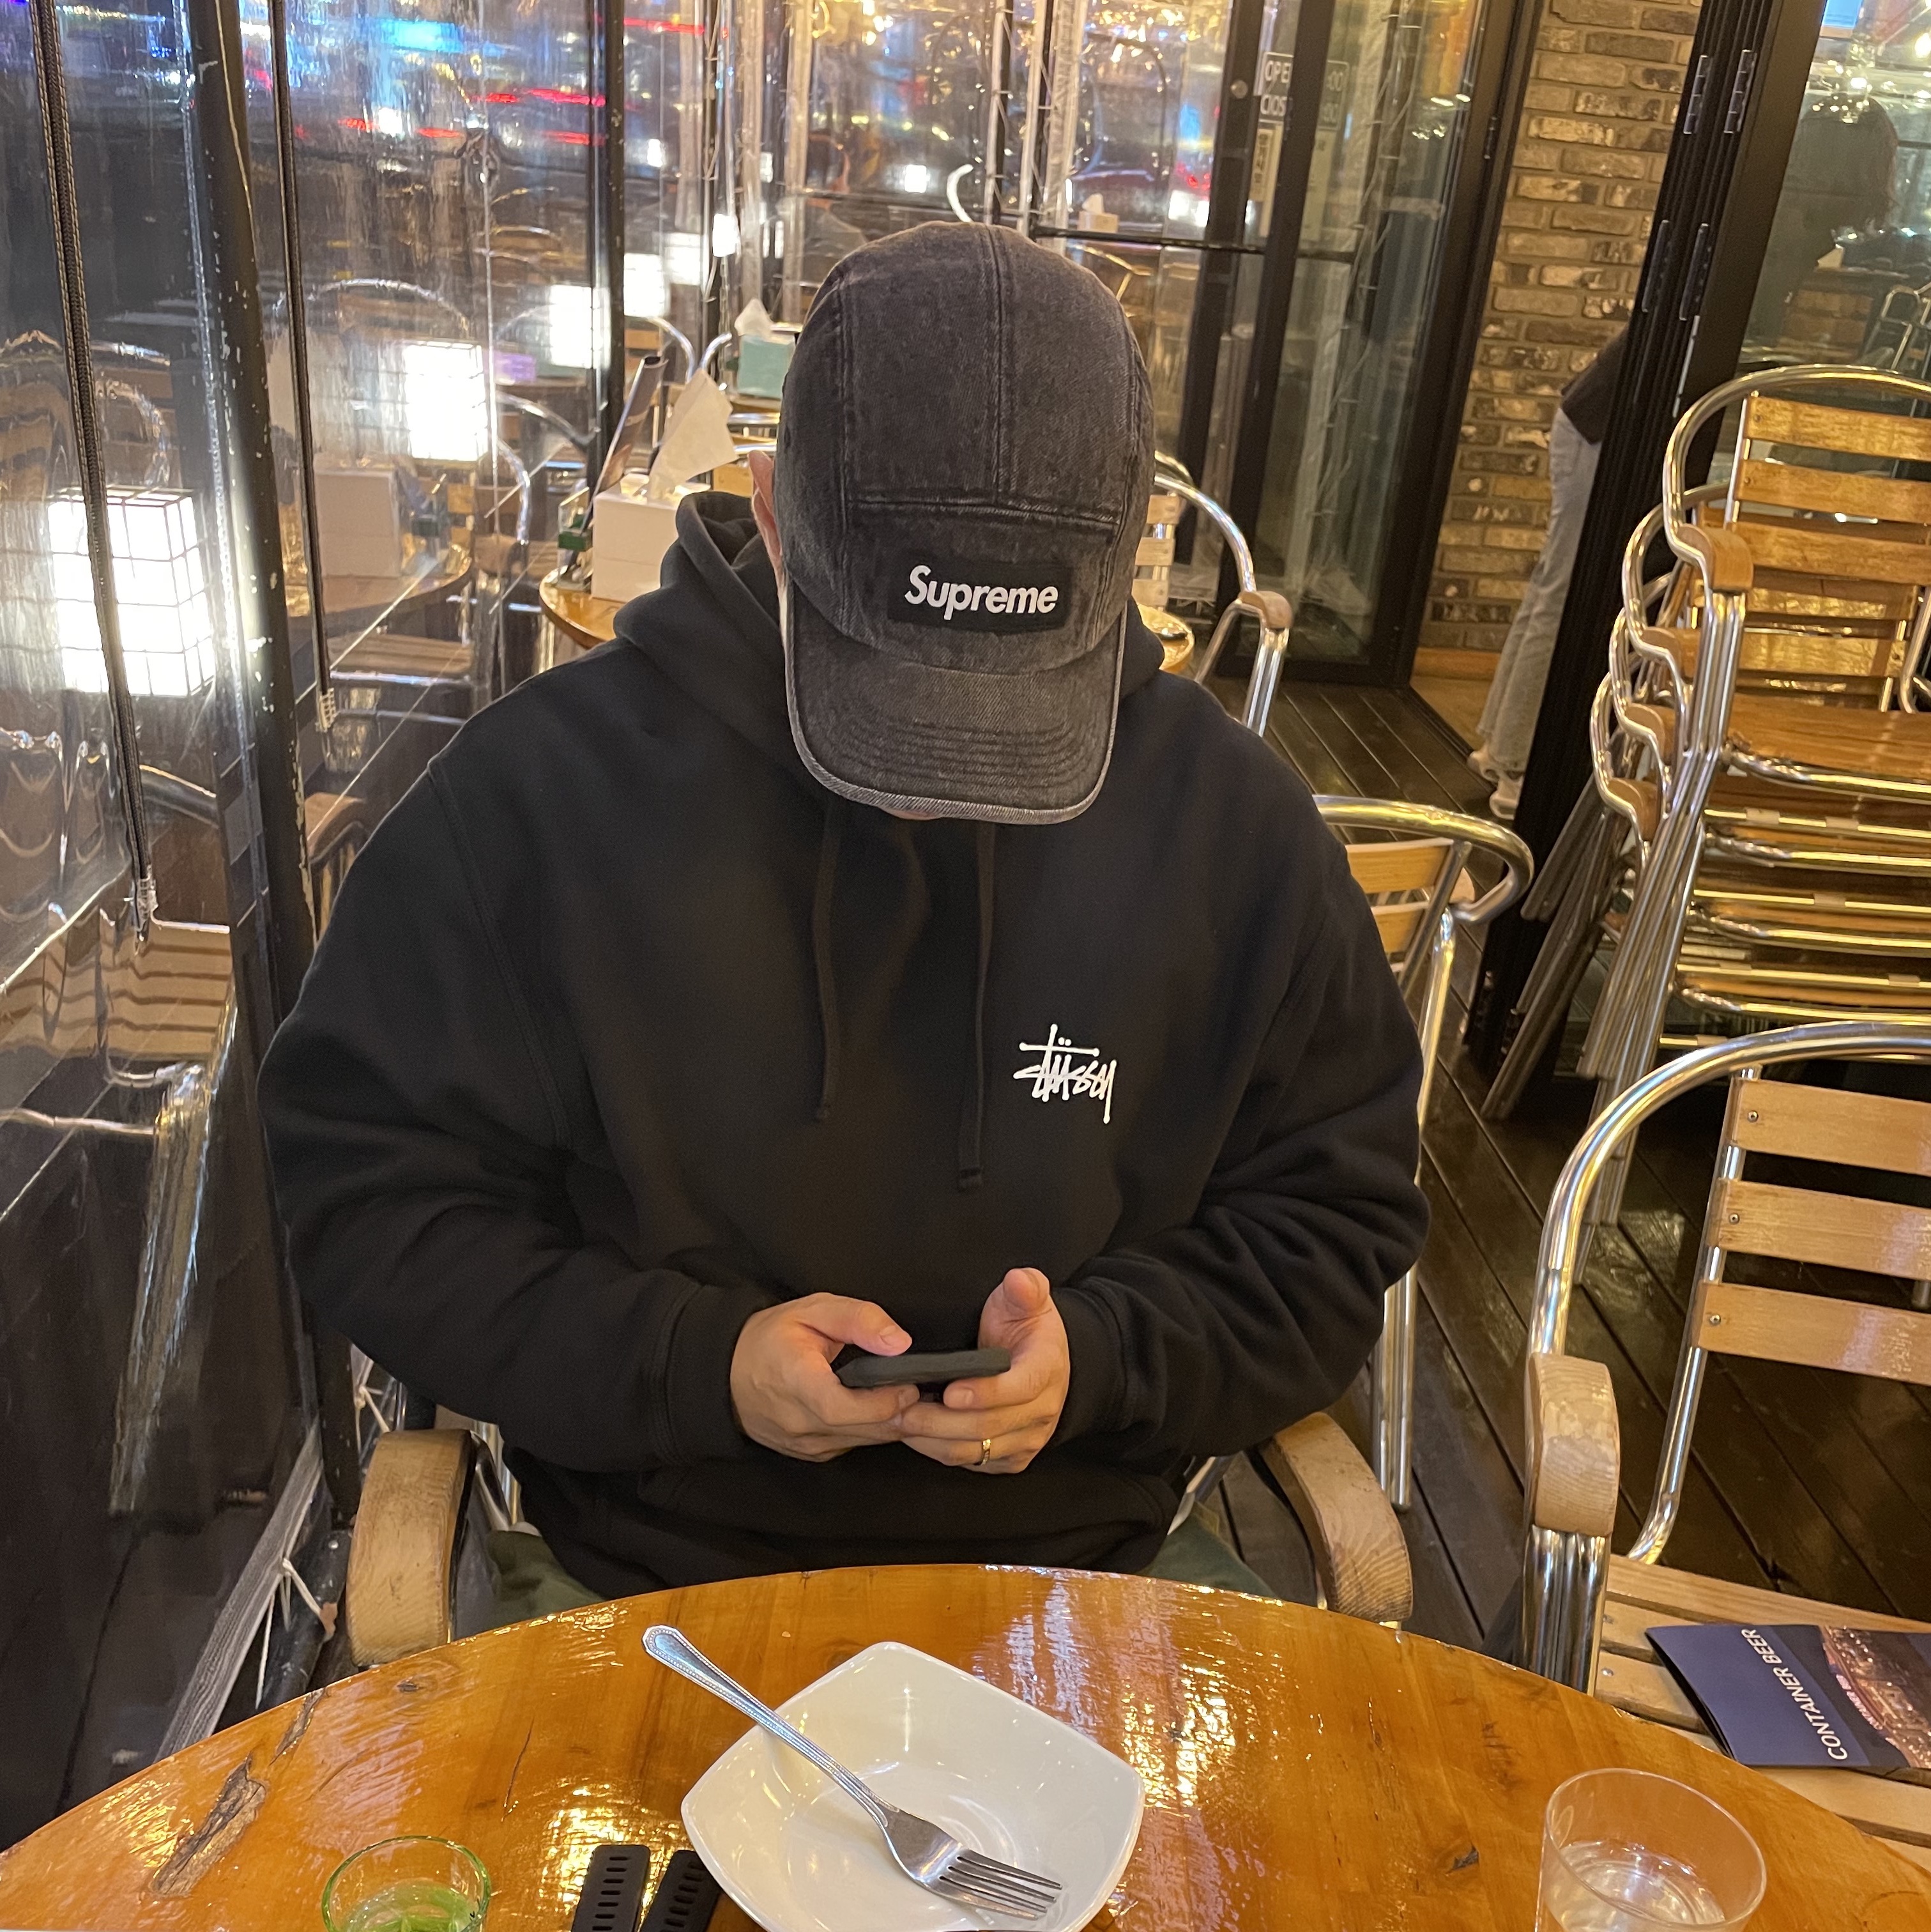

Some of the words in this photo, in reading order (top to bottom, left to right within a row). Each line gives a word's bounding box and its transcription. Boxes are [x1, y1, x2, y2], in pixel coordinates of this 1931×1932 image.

[1265, 60, 1291, 84] OPE
[1260, 94, 1288, 116] CLOS
[904, 565, 1058, 620] Supreme
[1741, 1629, 1782, 1664] BEER
[1773, 1667, 1847, 1759] CONTAINER
